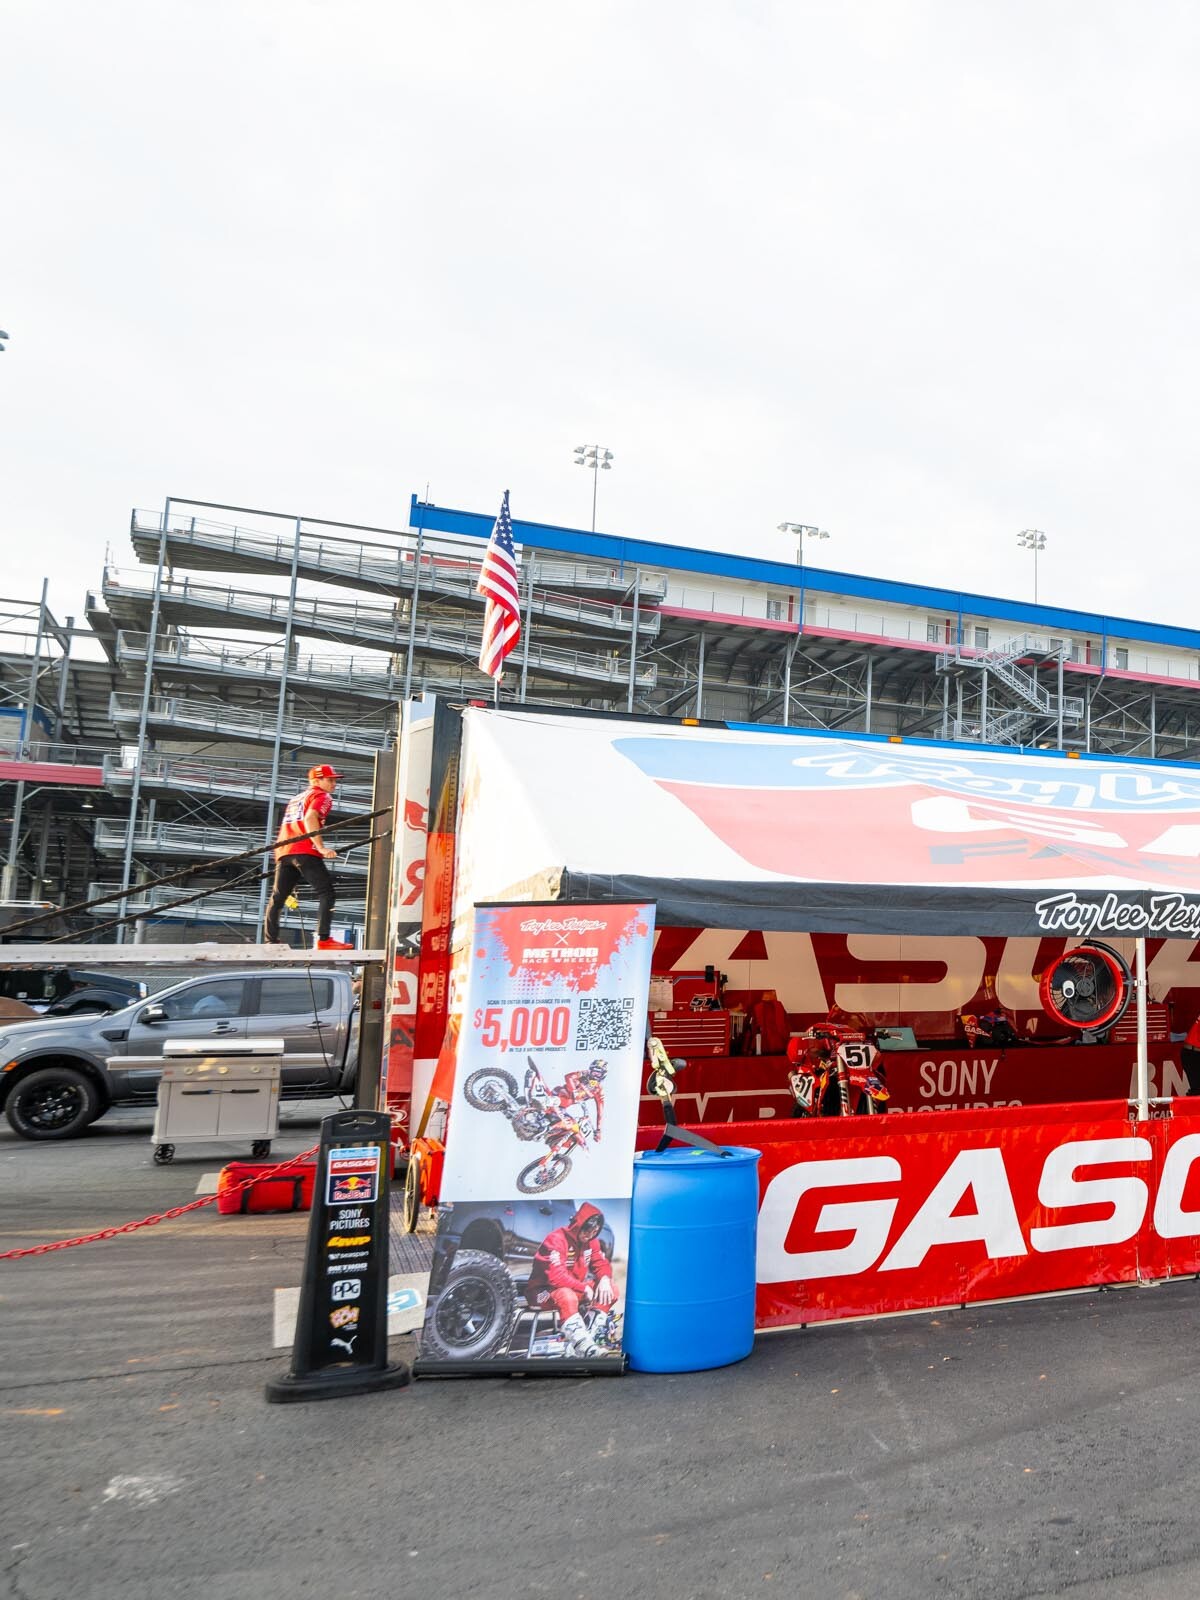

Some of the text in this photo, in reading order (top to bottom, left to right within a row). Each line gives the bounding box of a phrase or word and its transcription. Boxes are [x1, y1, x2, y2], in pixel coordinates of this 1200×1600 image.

[1036, 892, 1102, 936] Troy
[1097, 893, 1149, 930] Lee
[522, 947, 599, 959] METHOD
[473, 1006, 570, 1053] $5,000
[846, 1045, 871, 1067] 51
[919, 1058, 999, 1098] SONY
[332, 1160, 376, 1169] GASGAS
[333, 1189, 371, 1200] Red Bull
[339, 1208, 363, 1219] SONY
[329, 1218, 371, 1230] PICTURES
[334, 1282, 360, 1297] PPG
